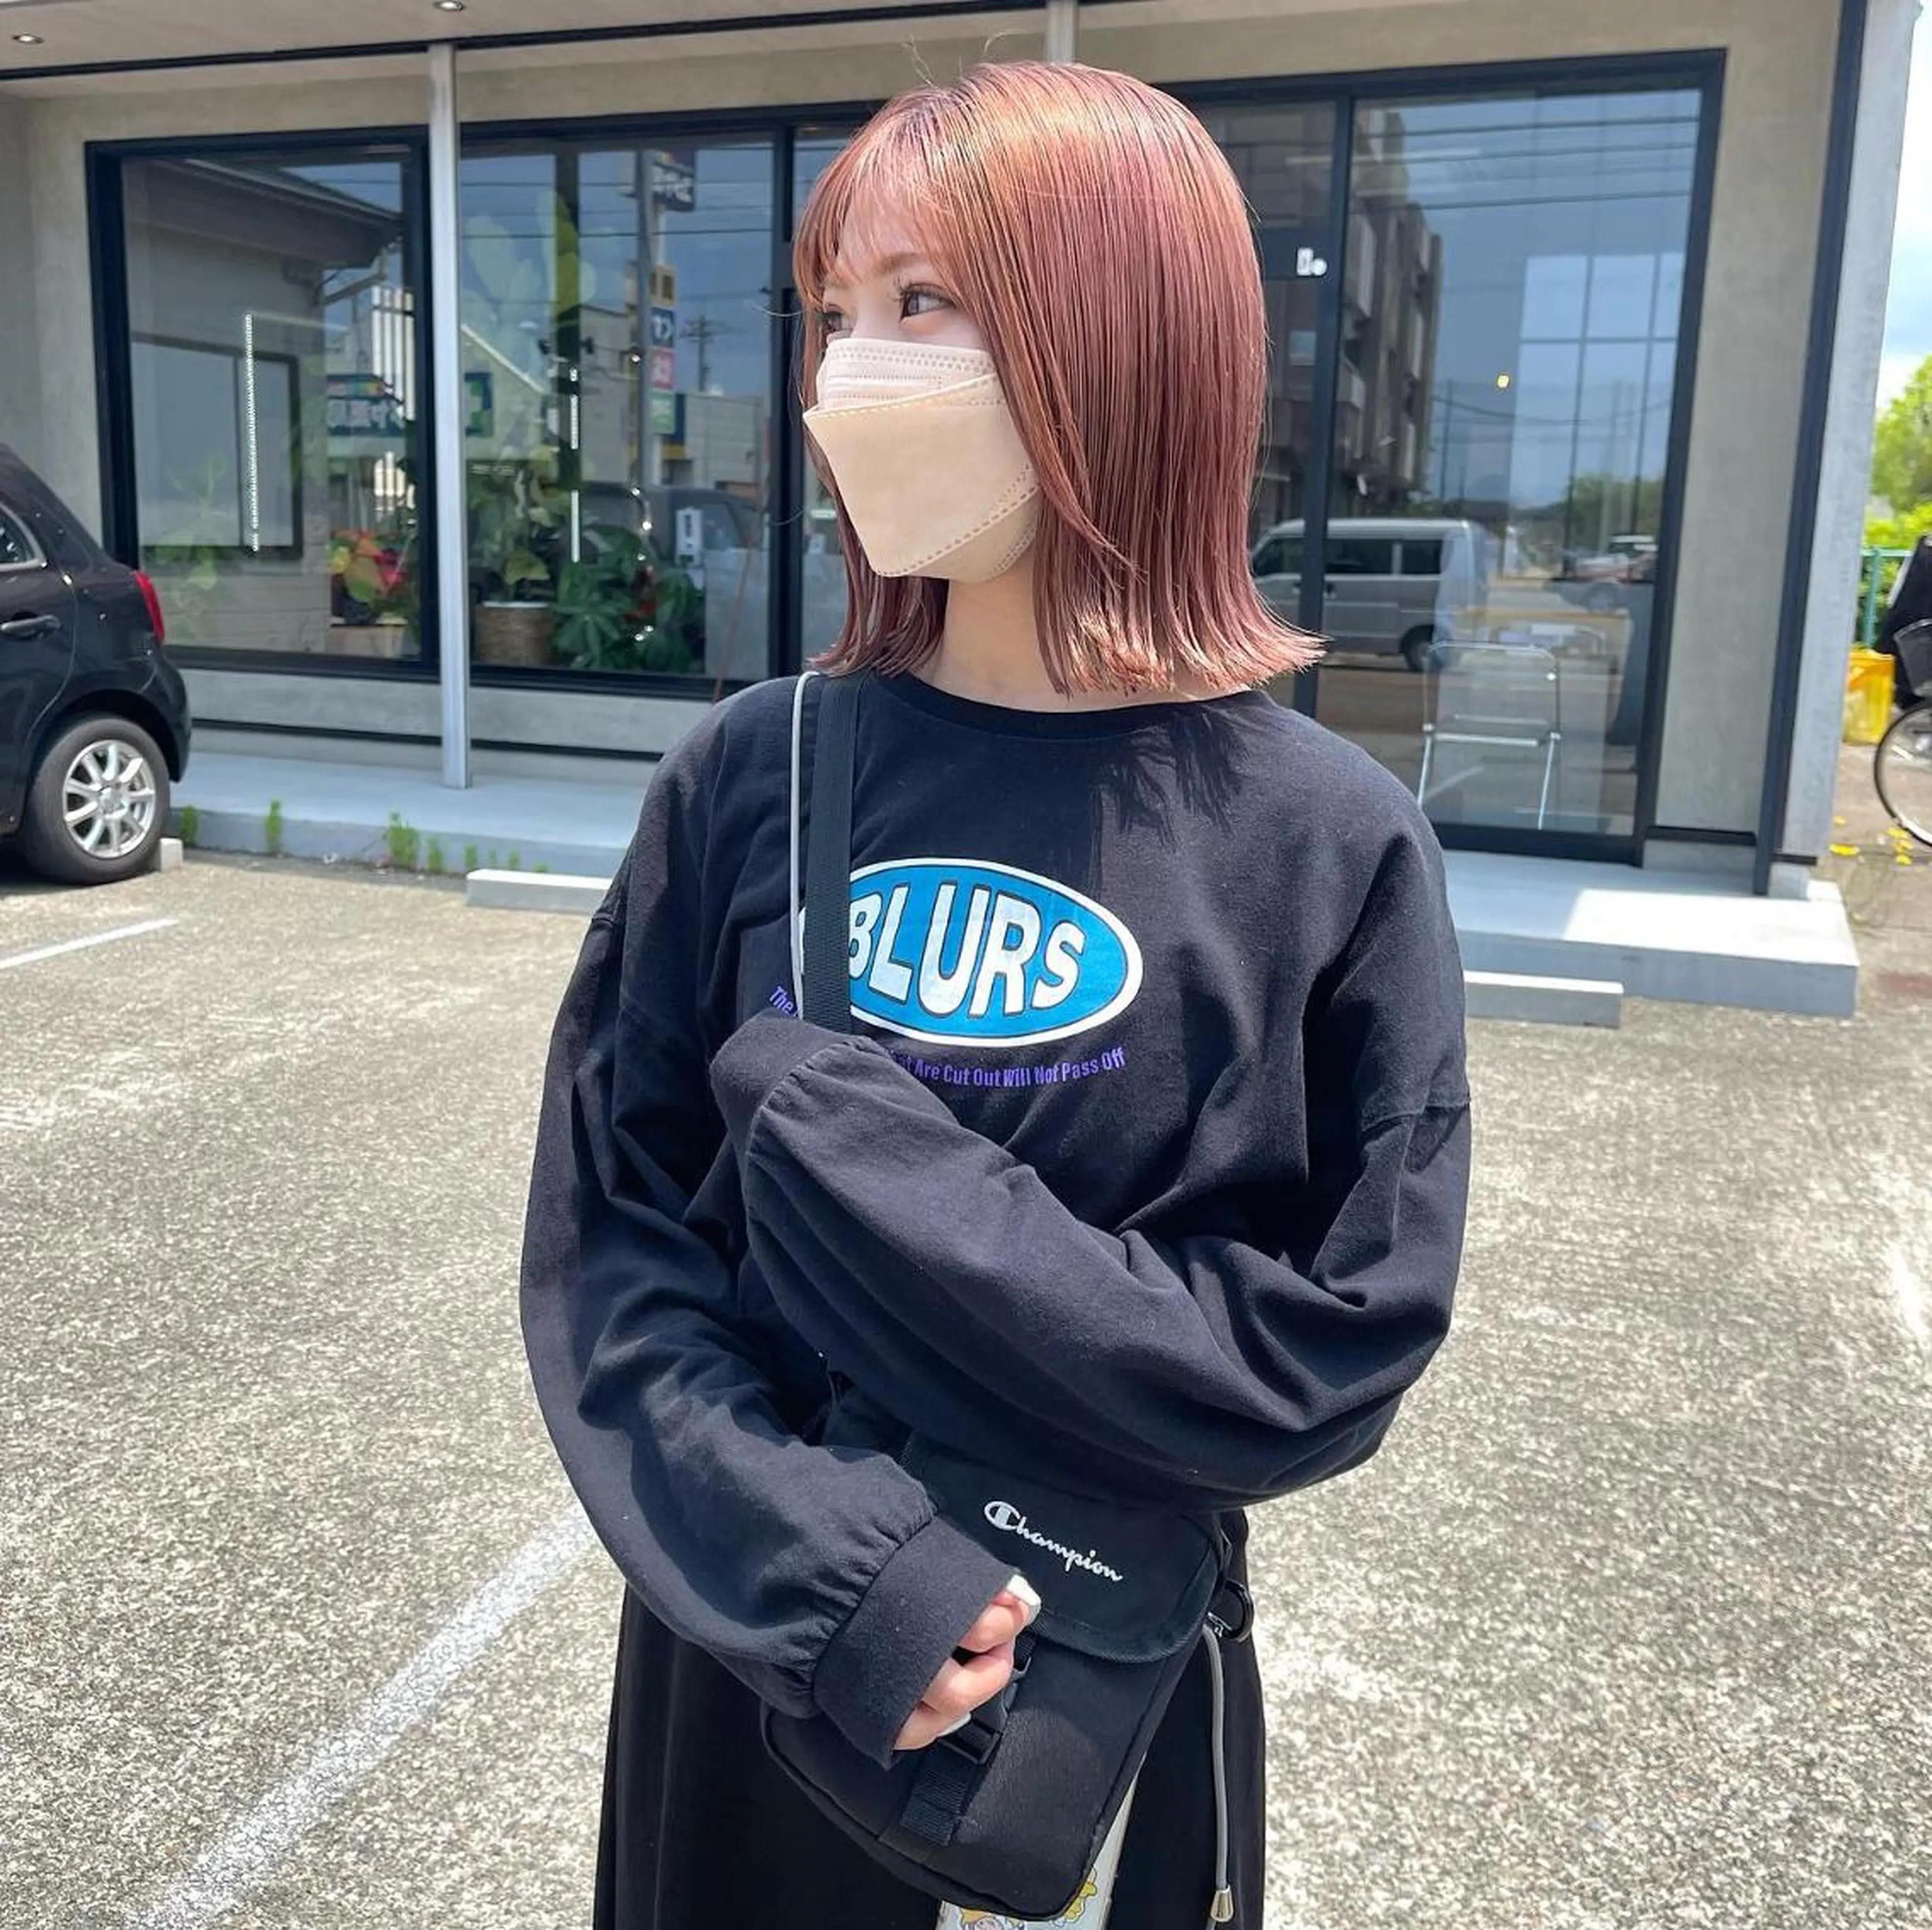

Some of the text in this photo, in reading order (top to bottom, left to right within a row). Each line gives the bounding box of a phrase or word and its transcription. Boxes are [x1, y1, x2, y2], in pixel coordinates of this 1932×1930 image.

[849, 883, 1086, 1017] BLURS
[769, 985, 794, 1017] The
[914, 1059, 939, 1080] Are
[943, 1064, 970, 1085] Cut
[973, 1068, 1001, 1086] Out
[1003, 1067, 1031, 1087] Will
[1034, 1065, 1059, 1085] Not
[1062, 1059, 1099, 1082] Pass
[1101, 1046, 1125, 1070] Off
[984, 1500, 1123, 1582] Champion
